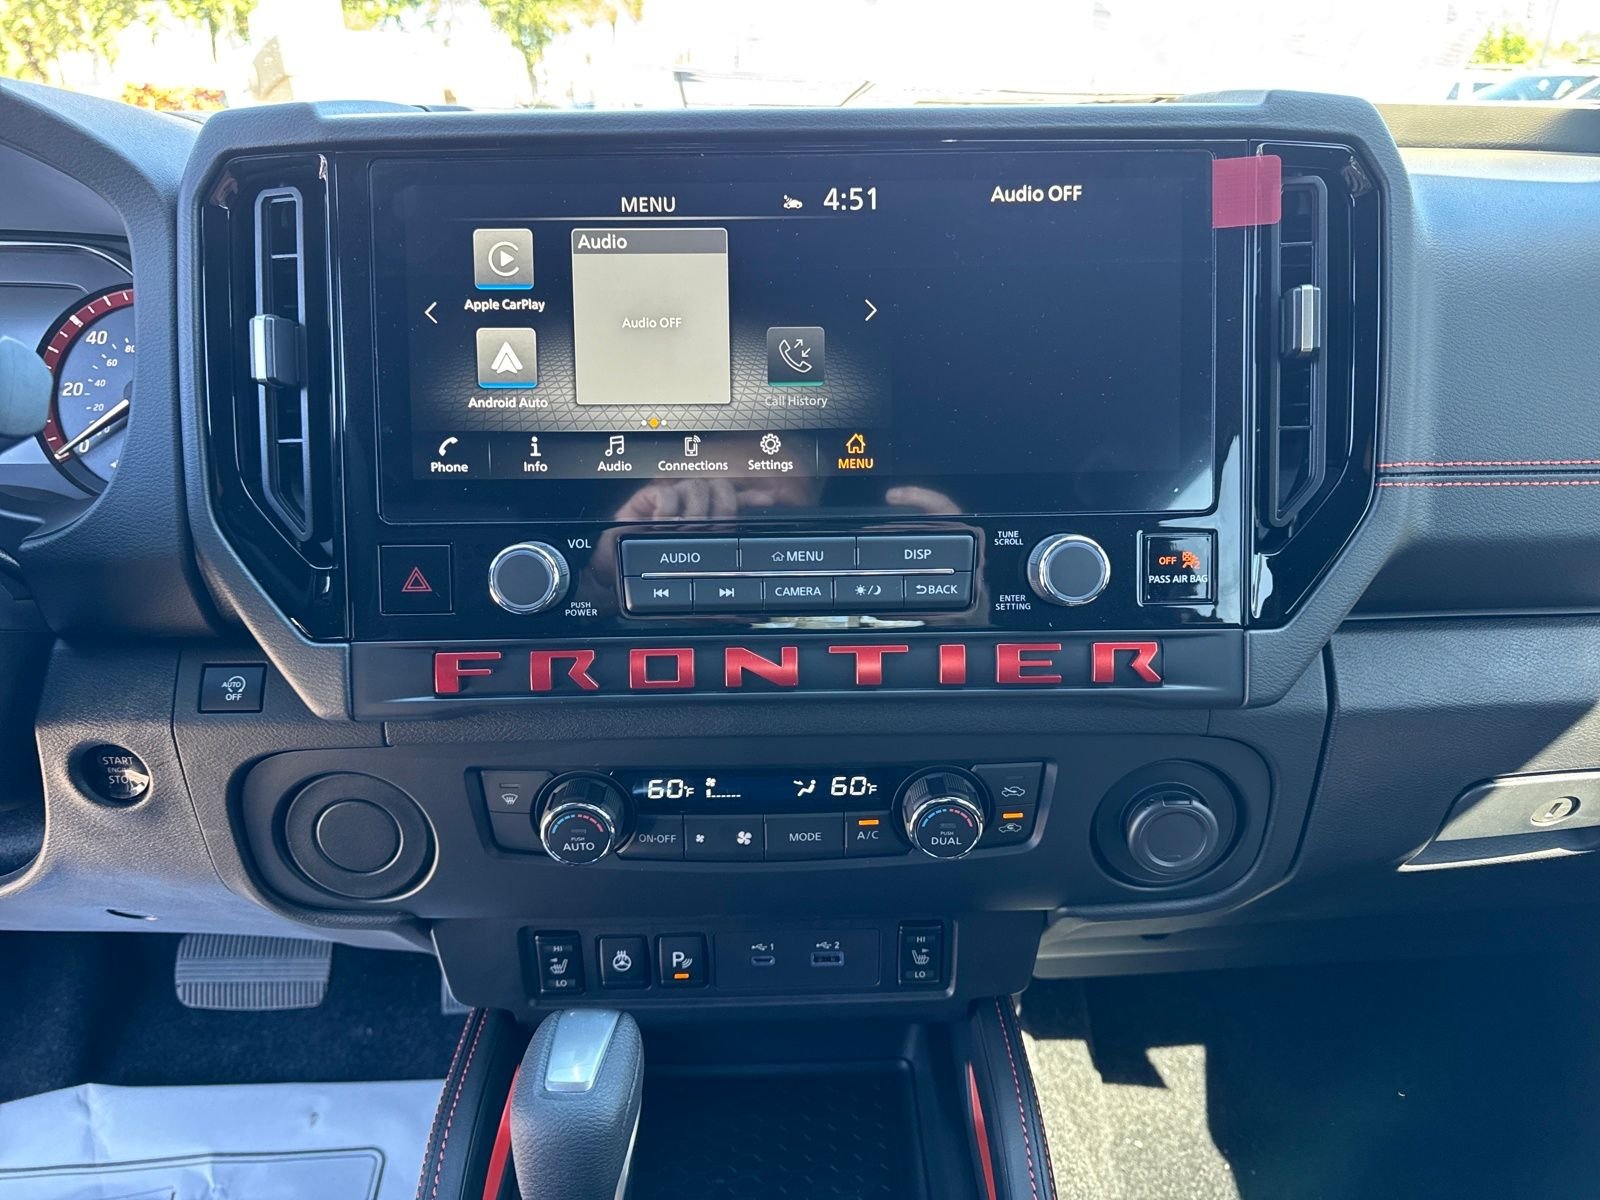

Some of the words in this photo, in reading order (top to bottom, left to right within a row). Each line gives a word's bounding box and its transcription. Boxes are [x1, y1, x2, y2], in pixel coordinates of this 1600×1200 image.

[824, 187, 878, 212] 4:51
[990, 185, 1044, 202] Audio
[1048, 185, 1083, 201] OFF
[620, 196, 677, 213] MENU
[577, 234, 628, 250] Audio
[464, 299, 499, 313] Apple
[501, 299, 546, 313] CarPlay
[622, 316, 655, 329] Audio
[658, 316, 682, 329] OFF
[85, 330, 108, 345] 40
[106, 358, 118, 367] 60
[62, 382, 84, 397] 20
[94, 379, 106, 388] 40
[92, 403, 105, 412] 20
[468, 396, 516, 409] Android
[518, 396, 548, 409] Auto
[764, 395, 785, 407] Call
[787, 395, 828, 409] History
[430, 460, 469, 473] Phone
[523, 460, 548, 473] Info
[597, 459, 632, 472] Audio
[658, 458, 728, 471] Connections
[747, 457, 793, 472] Settings
[838, 457, 874, 470] MENU
[997, 530, 1019, 539] TUNE
[567, 538, 592, 550] VOL
[994, 538, 1024, 546] SCROLL
[659, 552, 701, 565] AUDIO
[786, 550, 824, 563] MENU
[904, 548, 932, 560] DISP
[1158, 556, 1177, 565] OFF
[1148, 575, 1170, 584] PASS
[1172, 575, 1188, 583] AIR
[1190, 574, 1208, 583] BAG
[775, 586, 822, 597] CAMERA
[927, 584, 958, 595] BACK
[570, 601, 591, 609] PUSH
[999, 595, 1026, 603] ENTER
[564, 608, 598, 617] POWER
[995, 602, 1031, 611] SETTING
[433, 641, 1163, 695] FRONTIER
[225, 693, 243, 701] OFF
[102, 756, 134, 765] START
[108, 775, 134, 785] STO
[789, 832, 822, 842] MODE
[856, 830, 879, 840] A/C
[931, 836, 962, 846] DUAL
[562, 842, 595, 852] AUTO
[672, 951, 685, 968] P
[555, 979, 568, 987] LO
